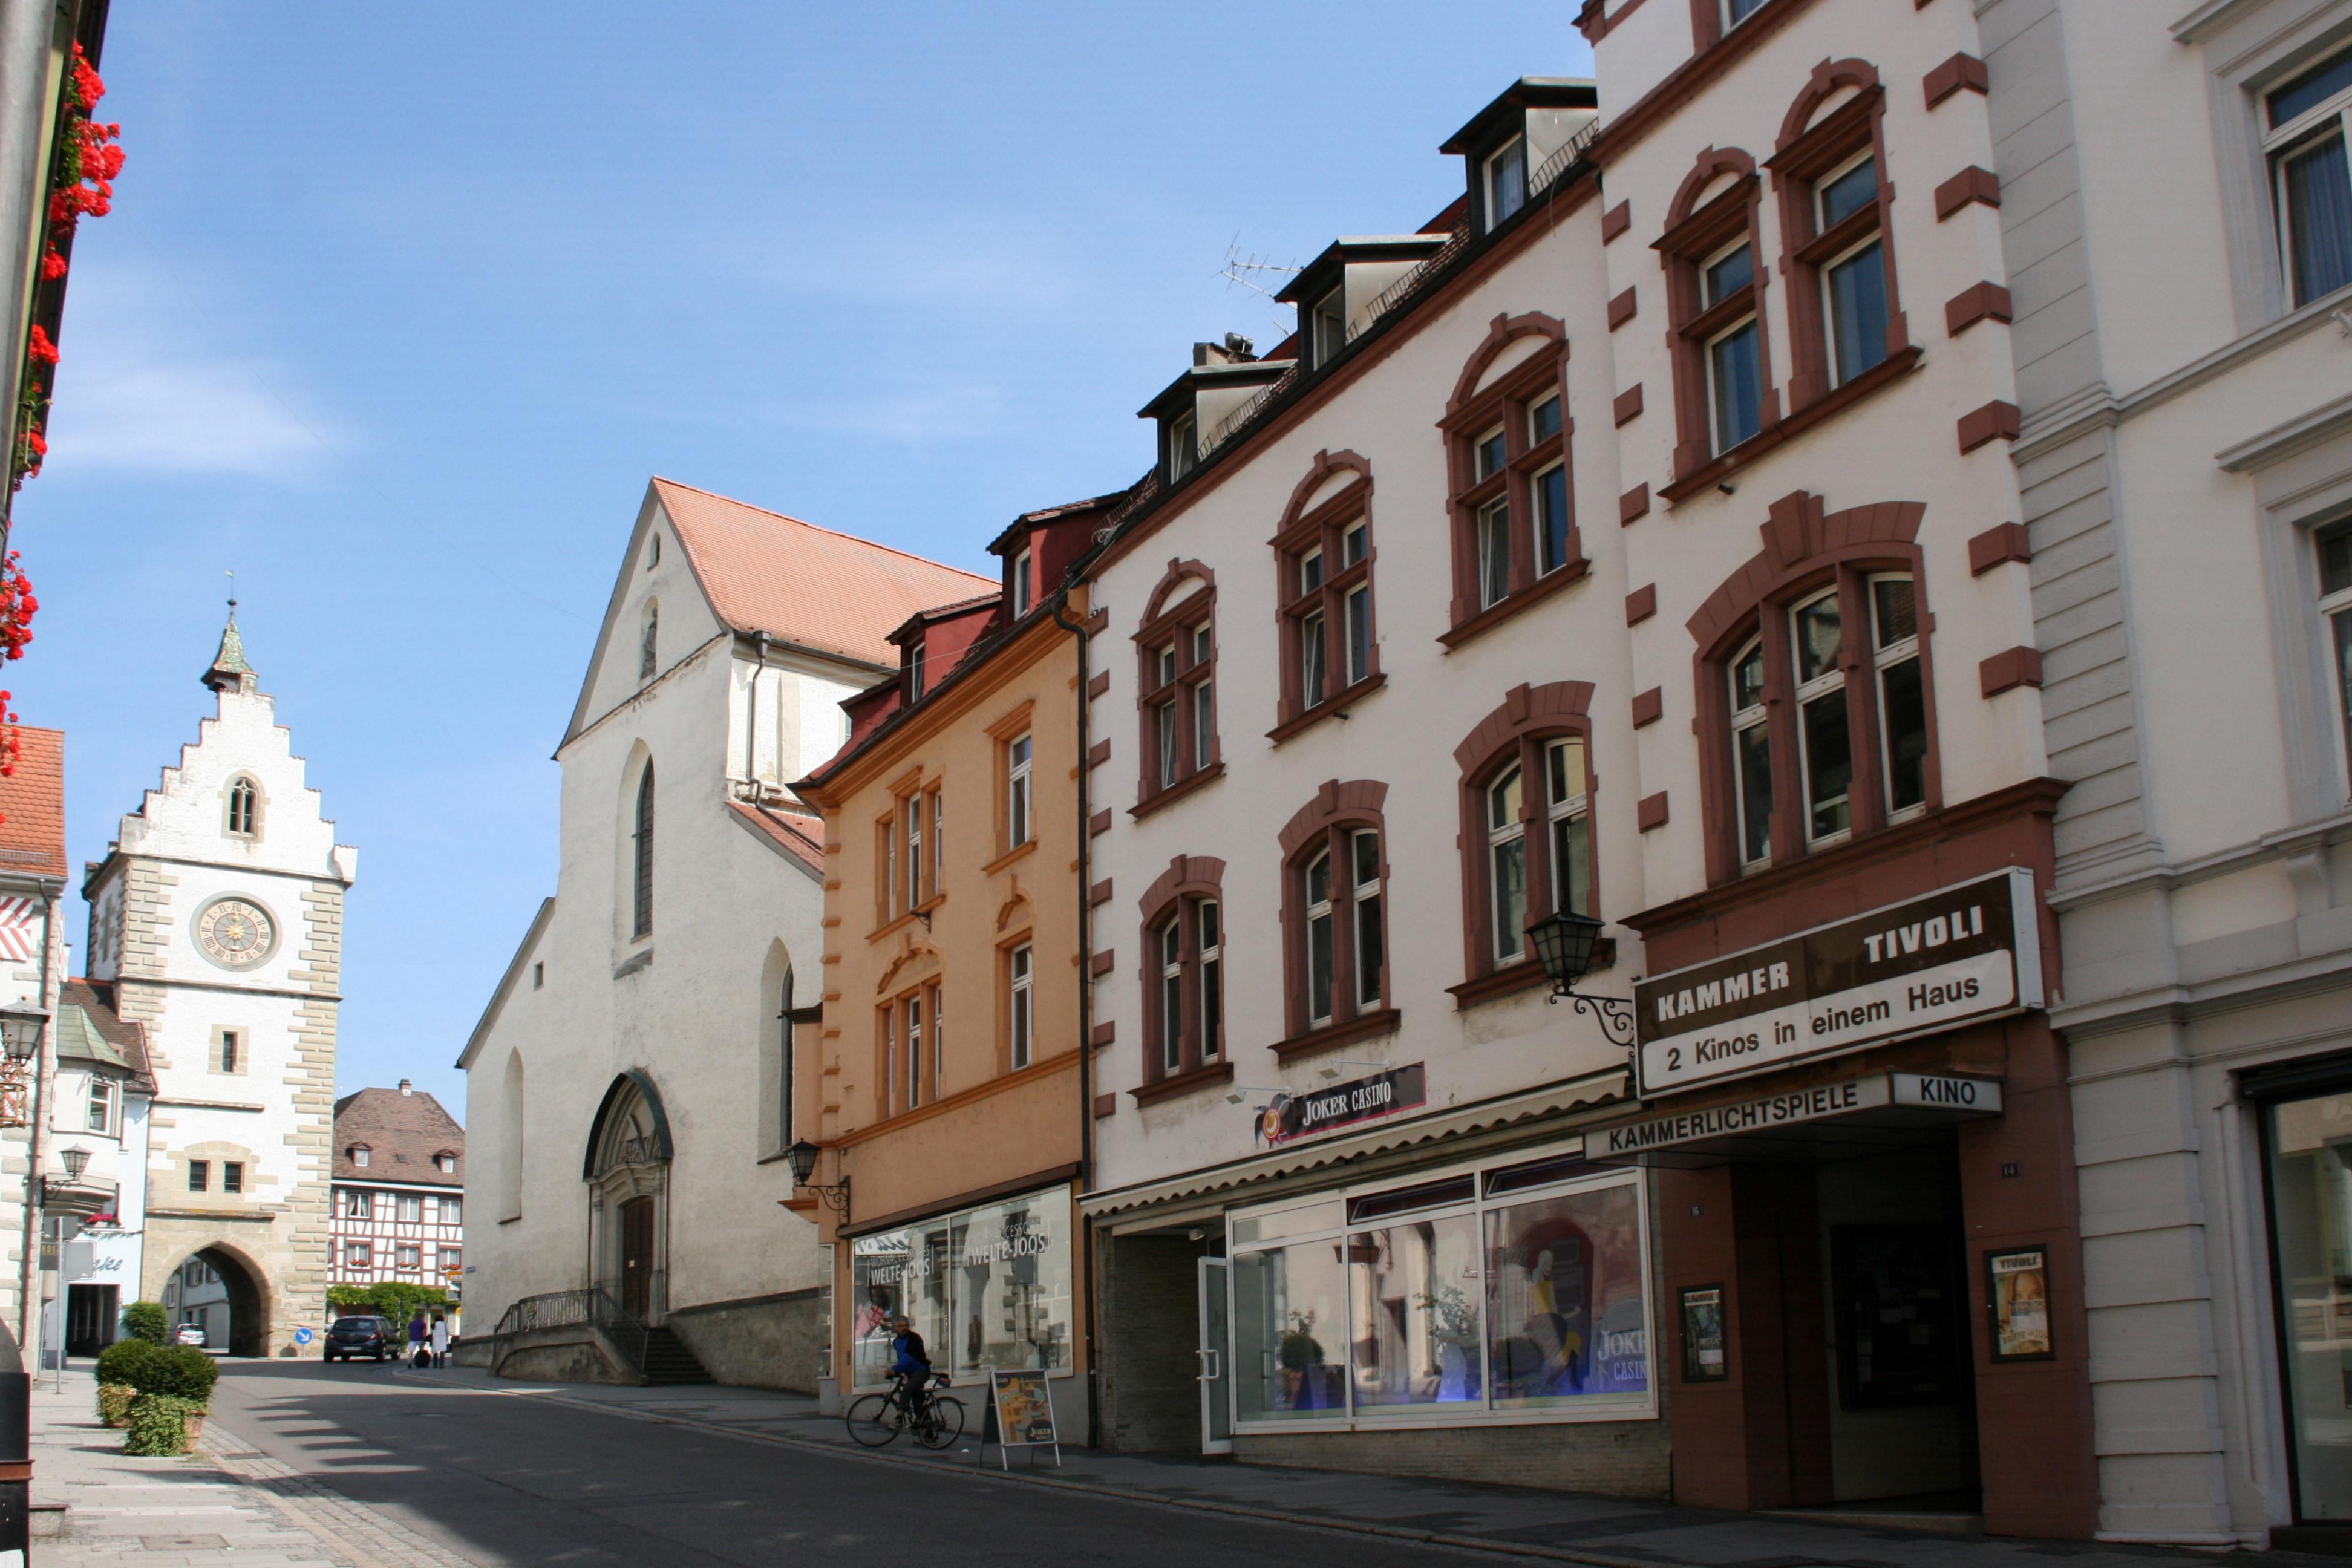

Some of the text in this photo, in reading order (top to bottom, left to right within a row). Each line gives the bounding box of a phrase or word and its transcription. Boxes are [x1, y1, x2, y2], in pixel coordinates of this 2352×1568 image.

[1863, 906, 1983, 963] TIVOLI
[1658, 961, 1789, 1022] KAMMER
[1667, 978, 1979, 1071] 2 Kinos in einem Haus
[1302, 1081, 1391, 1126] JOKER CASINO
[1920, 1077, 1976, 1105] KINO
[1609, 1083, 1858, 1151] KAMMERLICHTSPIELE
[871, 1258, 930, 1286] WELTE-JOOS
[972, 1232, 1045, 1266] WELTE-JOOS
